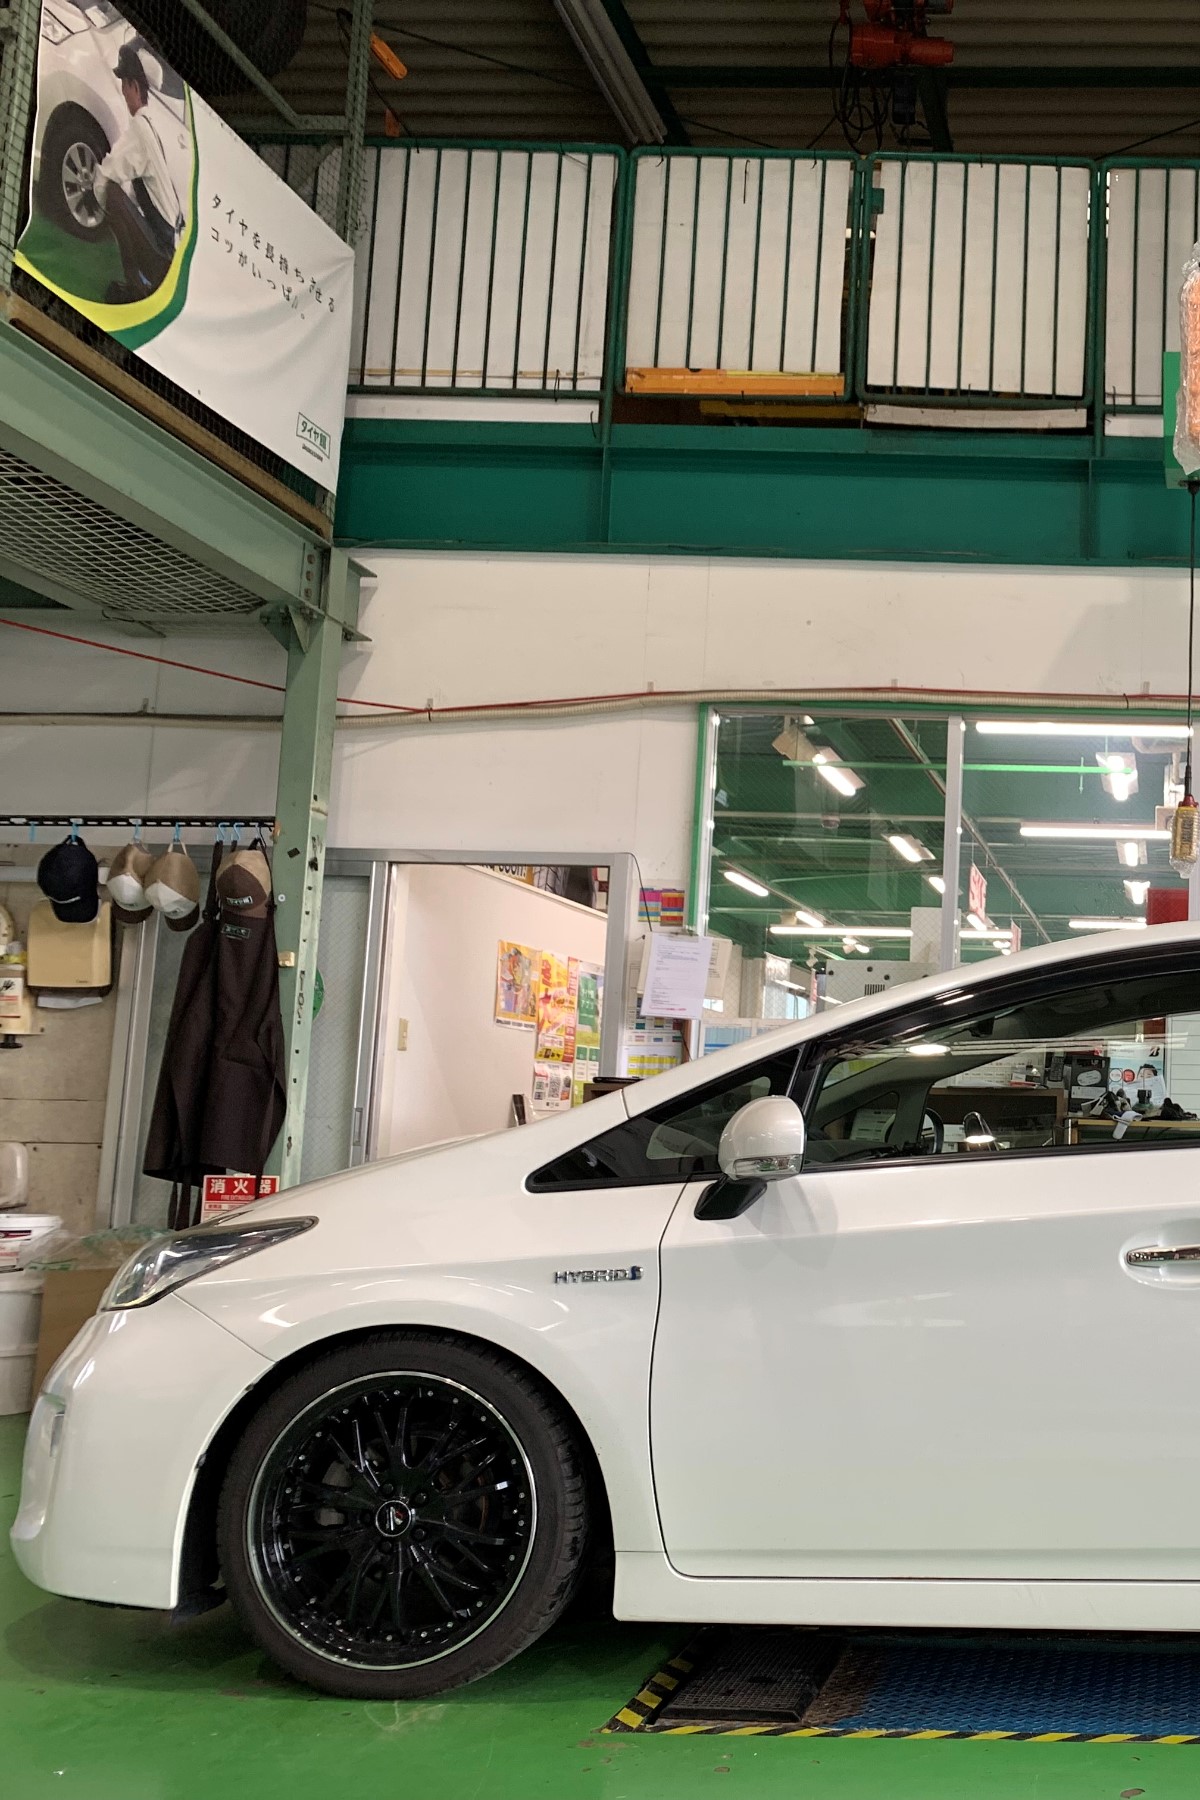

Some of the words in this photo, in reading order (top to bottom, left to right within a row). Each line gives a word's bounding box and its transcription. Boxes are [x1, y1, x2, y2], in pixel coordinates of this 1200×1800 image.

[211, 193, 335, 313] タイヤを長持ちさせる
[210, 1179, 271, 1194] 消火器
[554, 1270, 629, 1284] HYBRID
